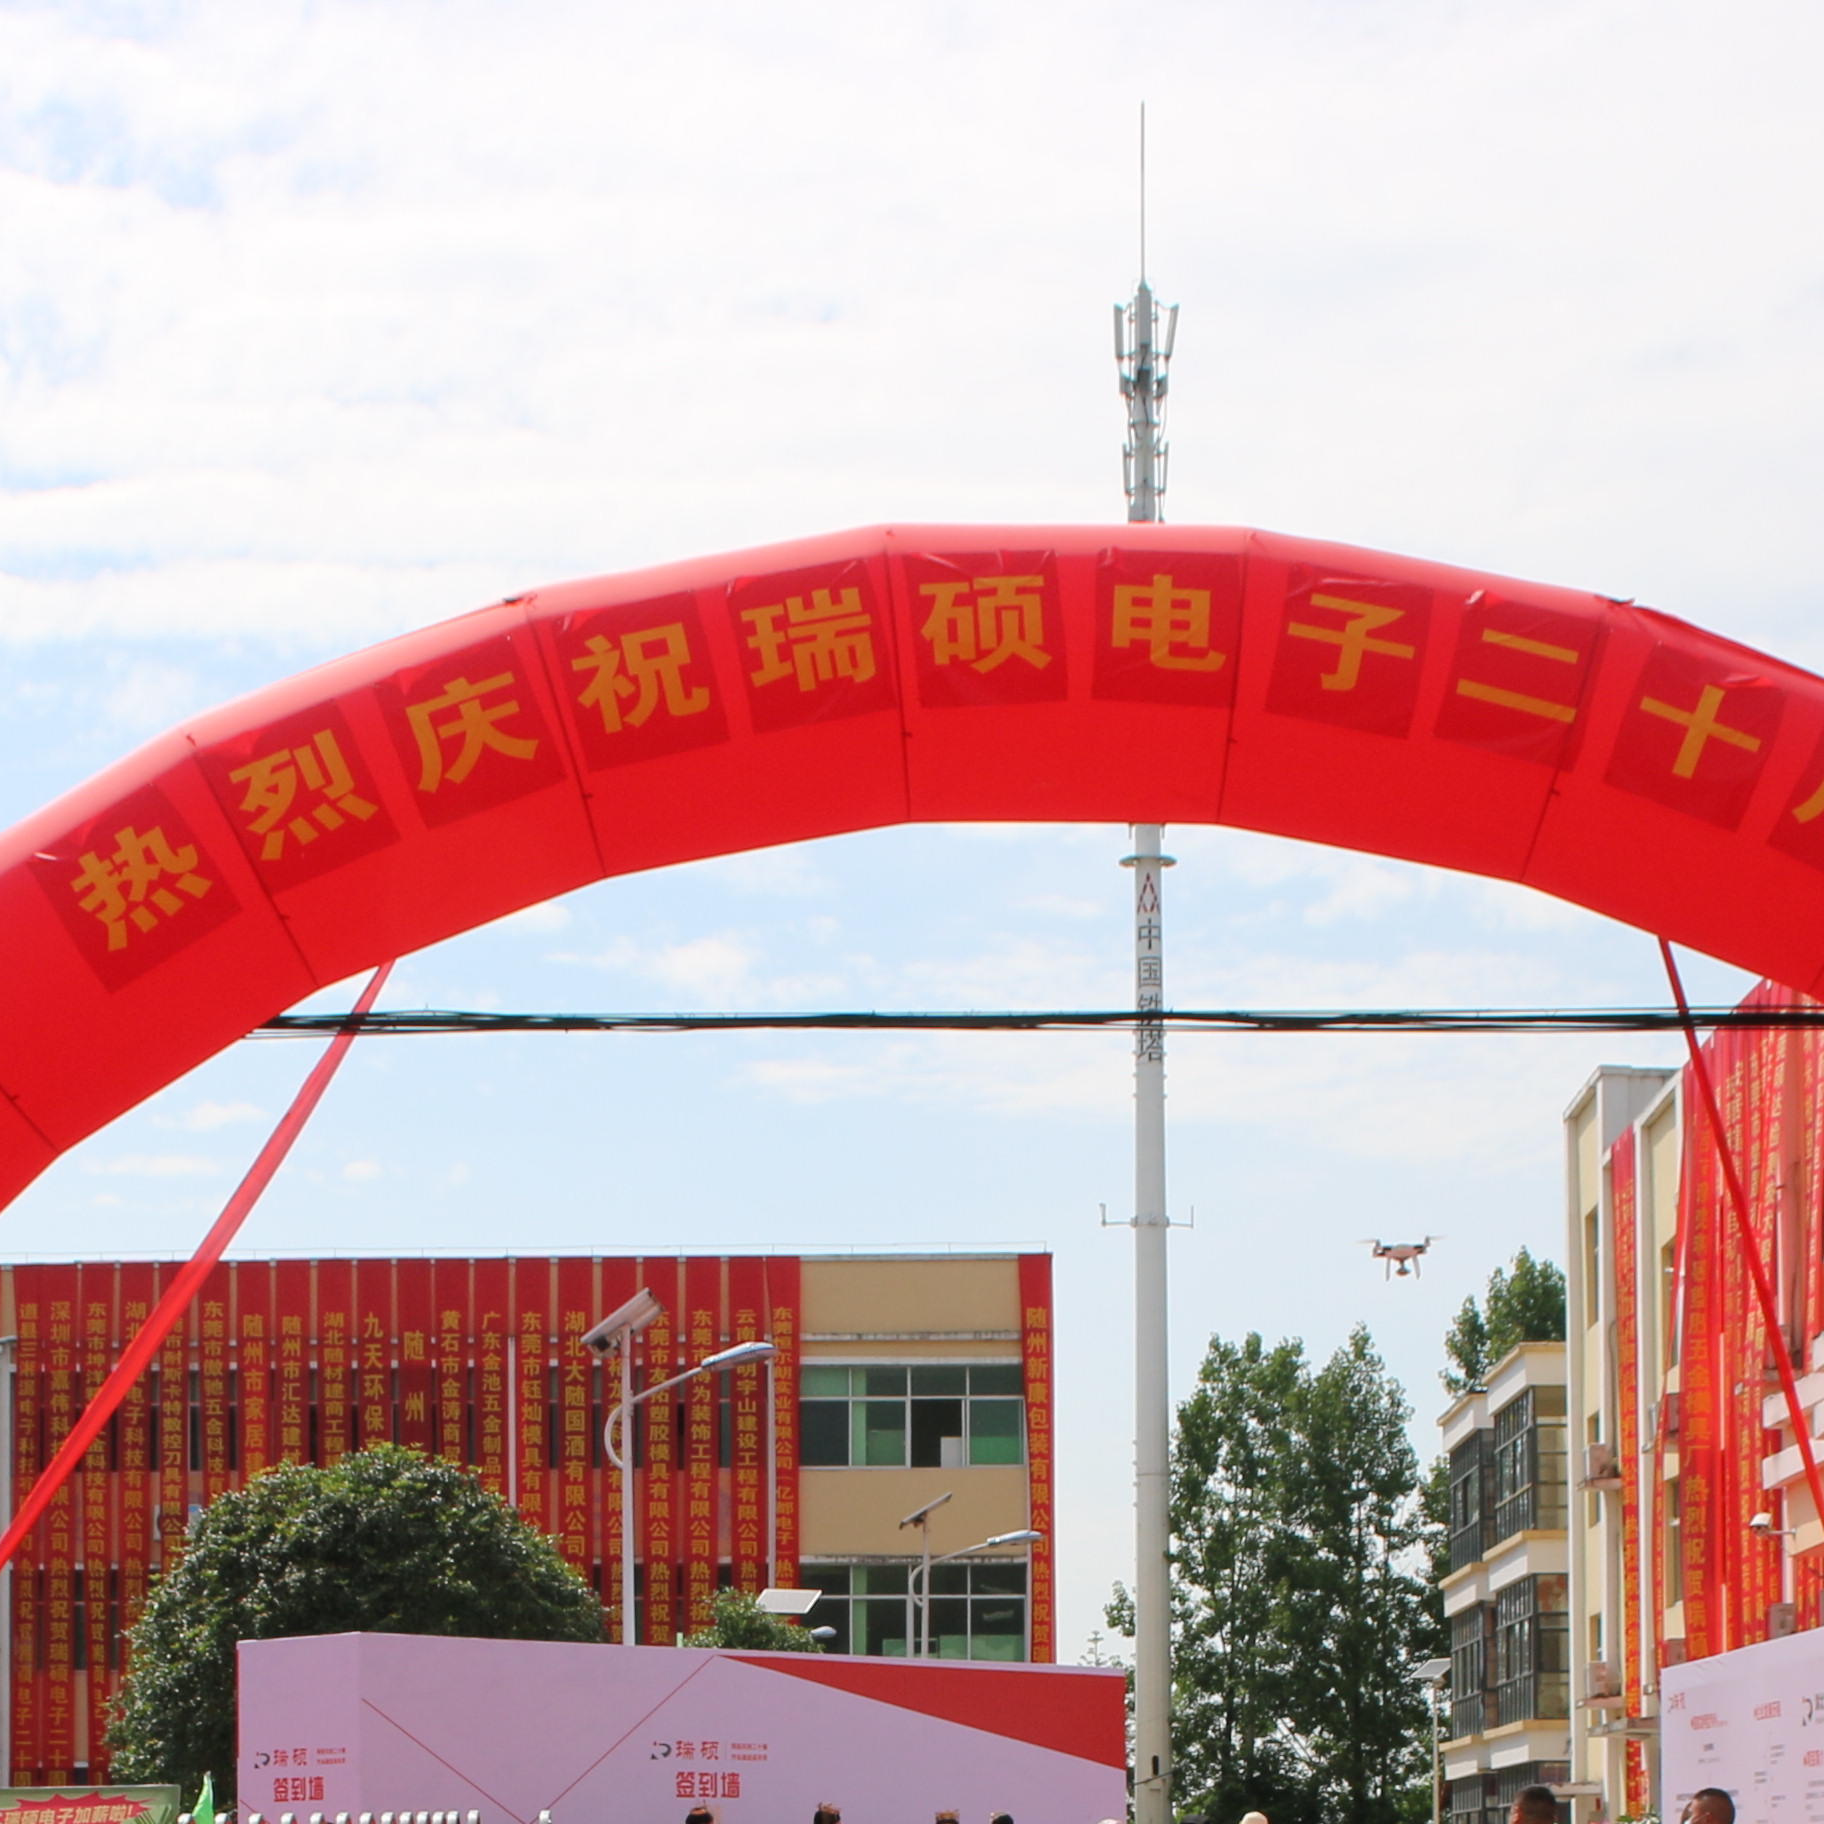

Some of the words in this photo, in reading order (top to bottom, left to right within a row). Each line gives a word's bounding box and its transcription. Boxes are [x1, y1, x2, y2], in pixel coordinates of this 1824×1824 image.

[675, 1740, 720, 1761] 瑞硕
[272, 1776, 324, 1802] 签到墙
[675, 1772, 741, 1799] 签到墙
